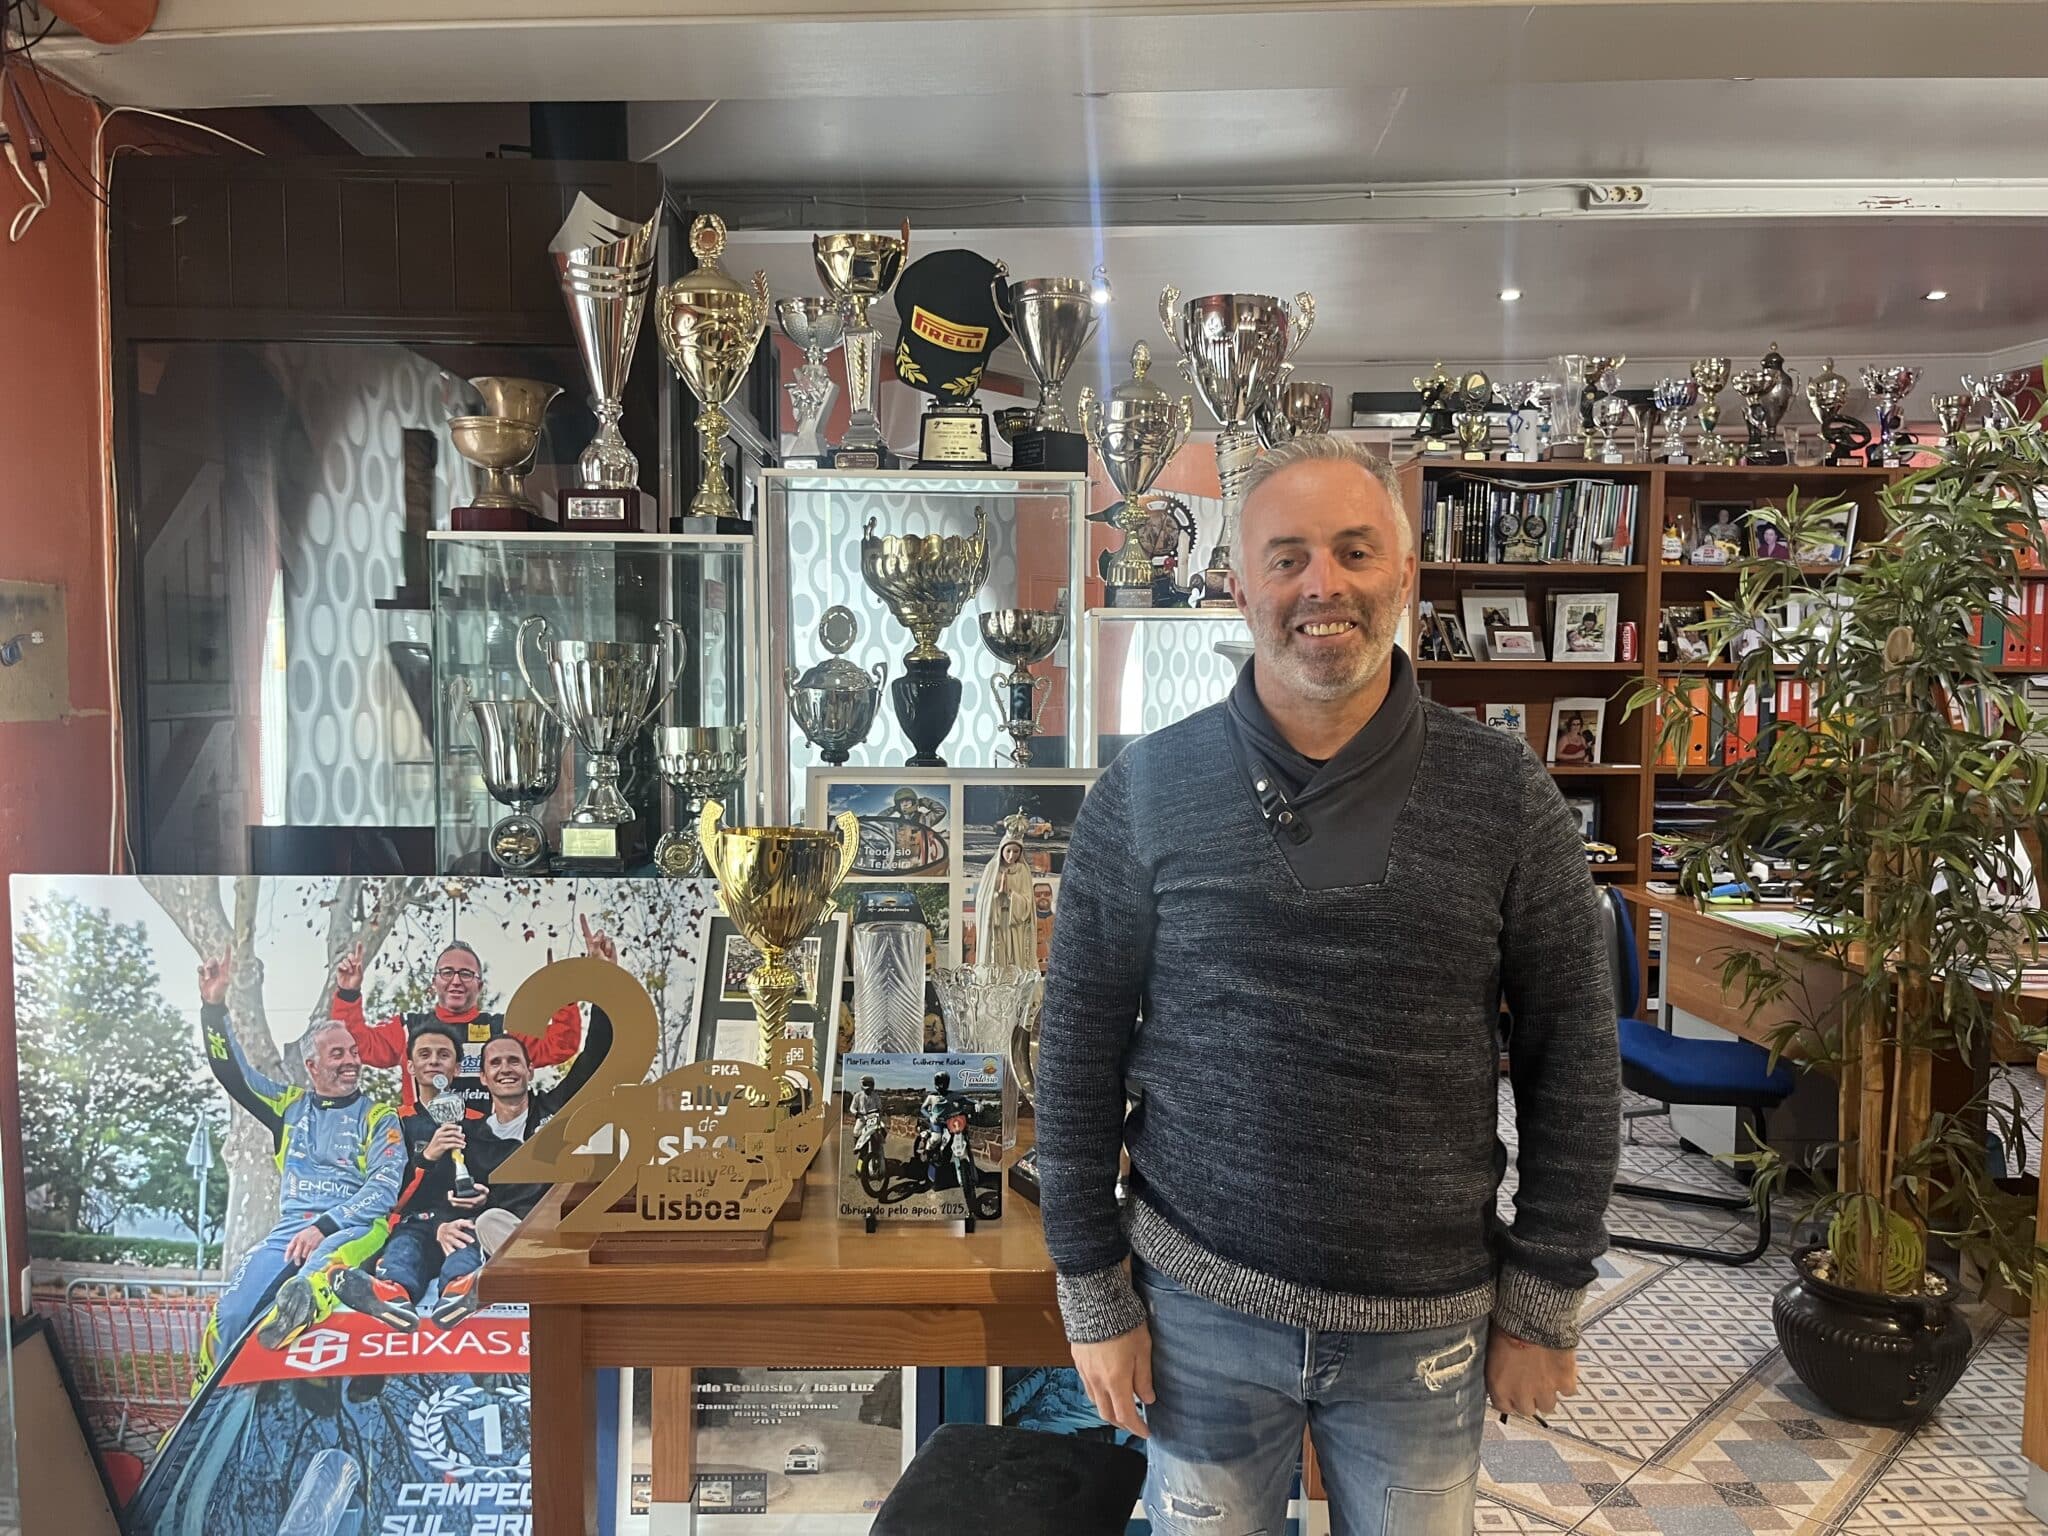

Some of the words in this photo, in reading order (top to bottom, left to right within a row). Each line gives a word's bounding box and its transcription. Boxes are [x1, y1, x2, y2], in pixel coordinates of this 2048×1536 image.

[914, 312, 984, 349] PIRELLI
[864, 846, 911, 857] Teodsio
[658, 1086, 732, 1116] Rally
[699, 1117, 719, 1132] de
[667, 1166, 719, 1186] Rally
[299, 1180, 353, 1196] ENCIVIL
[696, 1187, 709, 1198] de
[642, 1194, 741, 1221] Lisboa
[888, 1204, 908, 1217] pelo
[912, 1206, 937, 1217] apoio
[359, 1331, 512, 1357] SEIXAS
[697, 1383, 721, 1393] rdo
[850, 1383, 876, 1393] Luz
[470, 1514, 533, 1536] 2R
